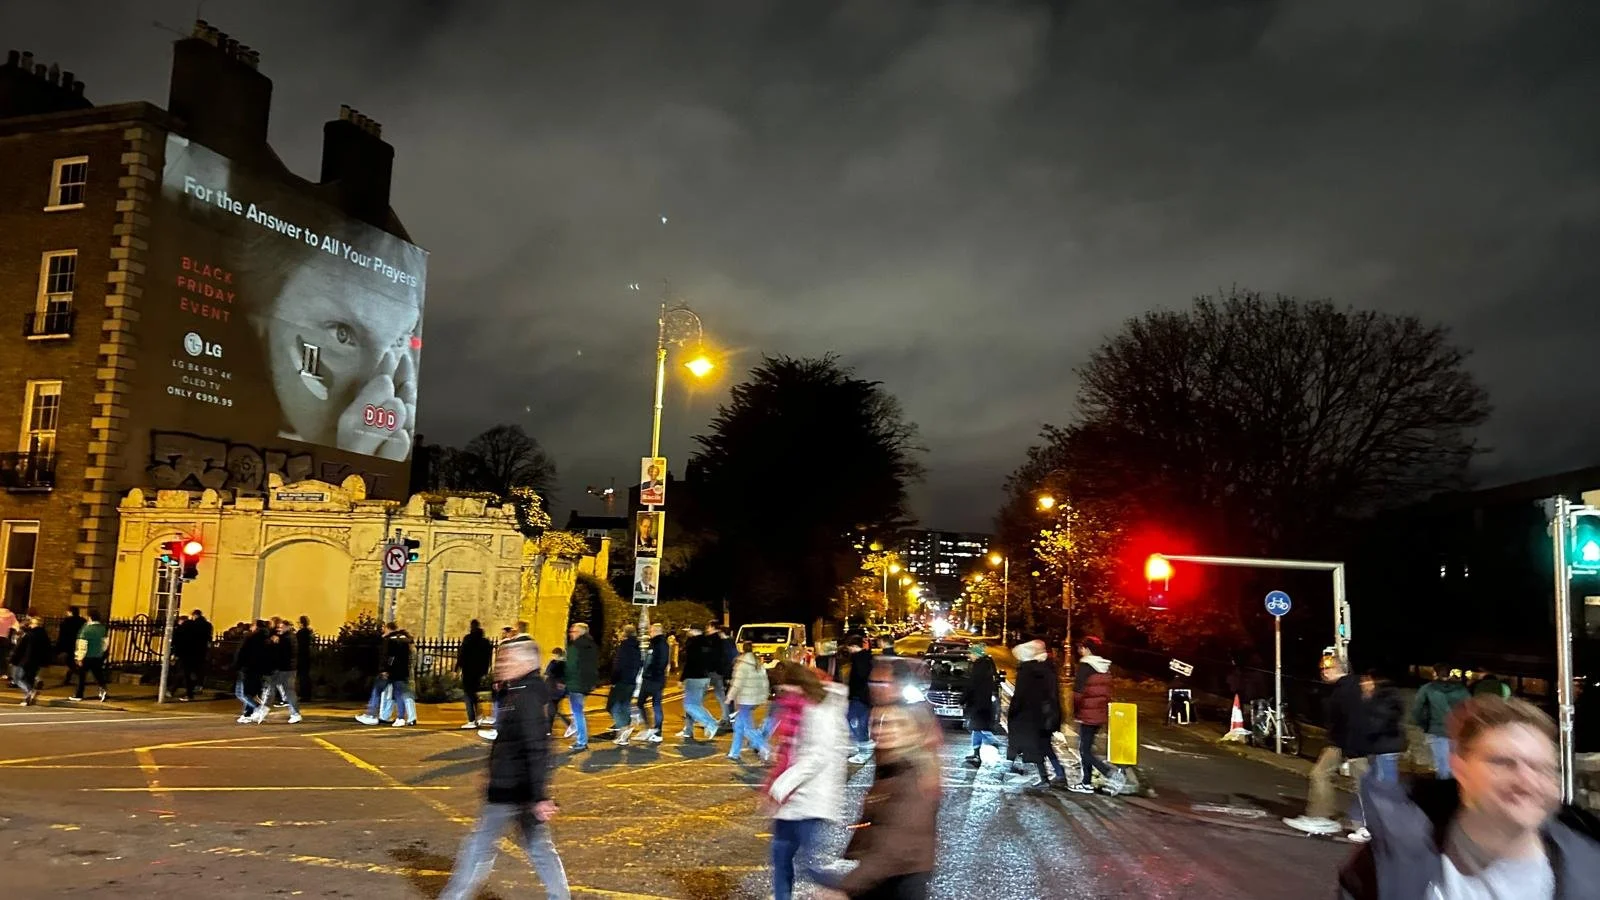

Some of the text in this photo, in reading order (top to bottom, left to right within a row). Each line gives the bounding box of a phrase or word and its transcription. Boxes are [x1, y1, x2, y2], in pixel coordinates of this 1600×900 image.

[183, 176, 417, 288] For the Answer to All Your Prayers
[181, 256, 233, 284] BLACK
[177, 275, 236, 304] FRIDAY
[180, 297, 230, 322] EVENT
[205, 341, 223, 358] LG
[172, 360, 184, 369] LG
[221, 371, 232, 380] 4K
[167, 385, 192, 398] ONLY
[182, 375, 221, 391] OLED TV
[365, 408, 395, 427] DID
